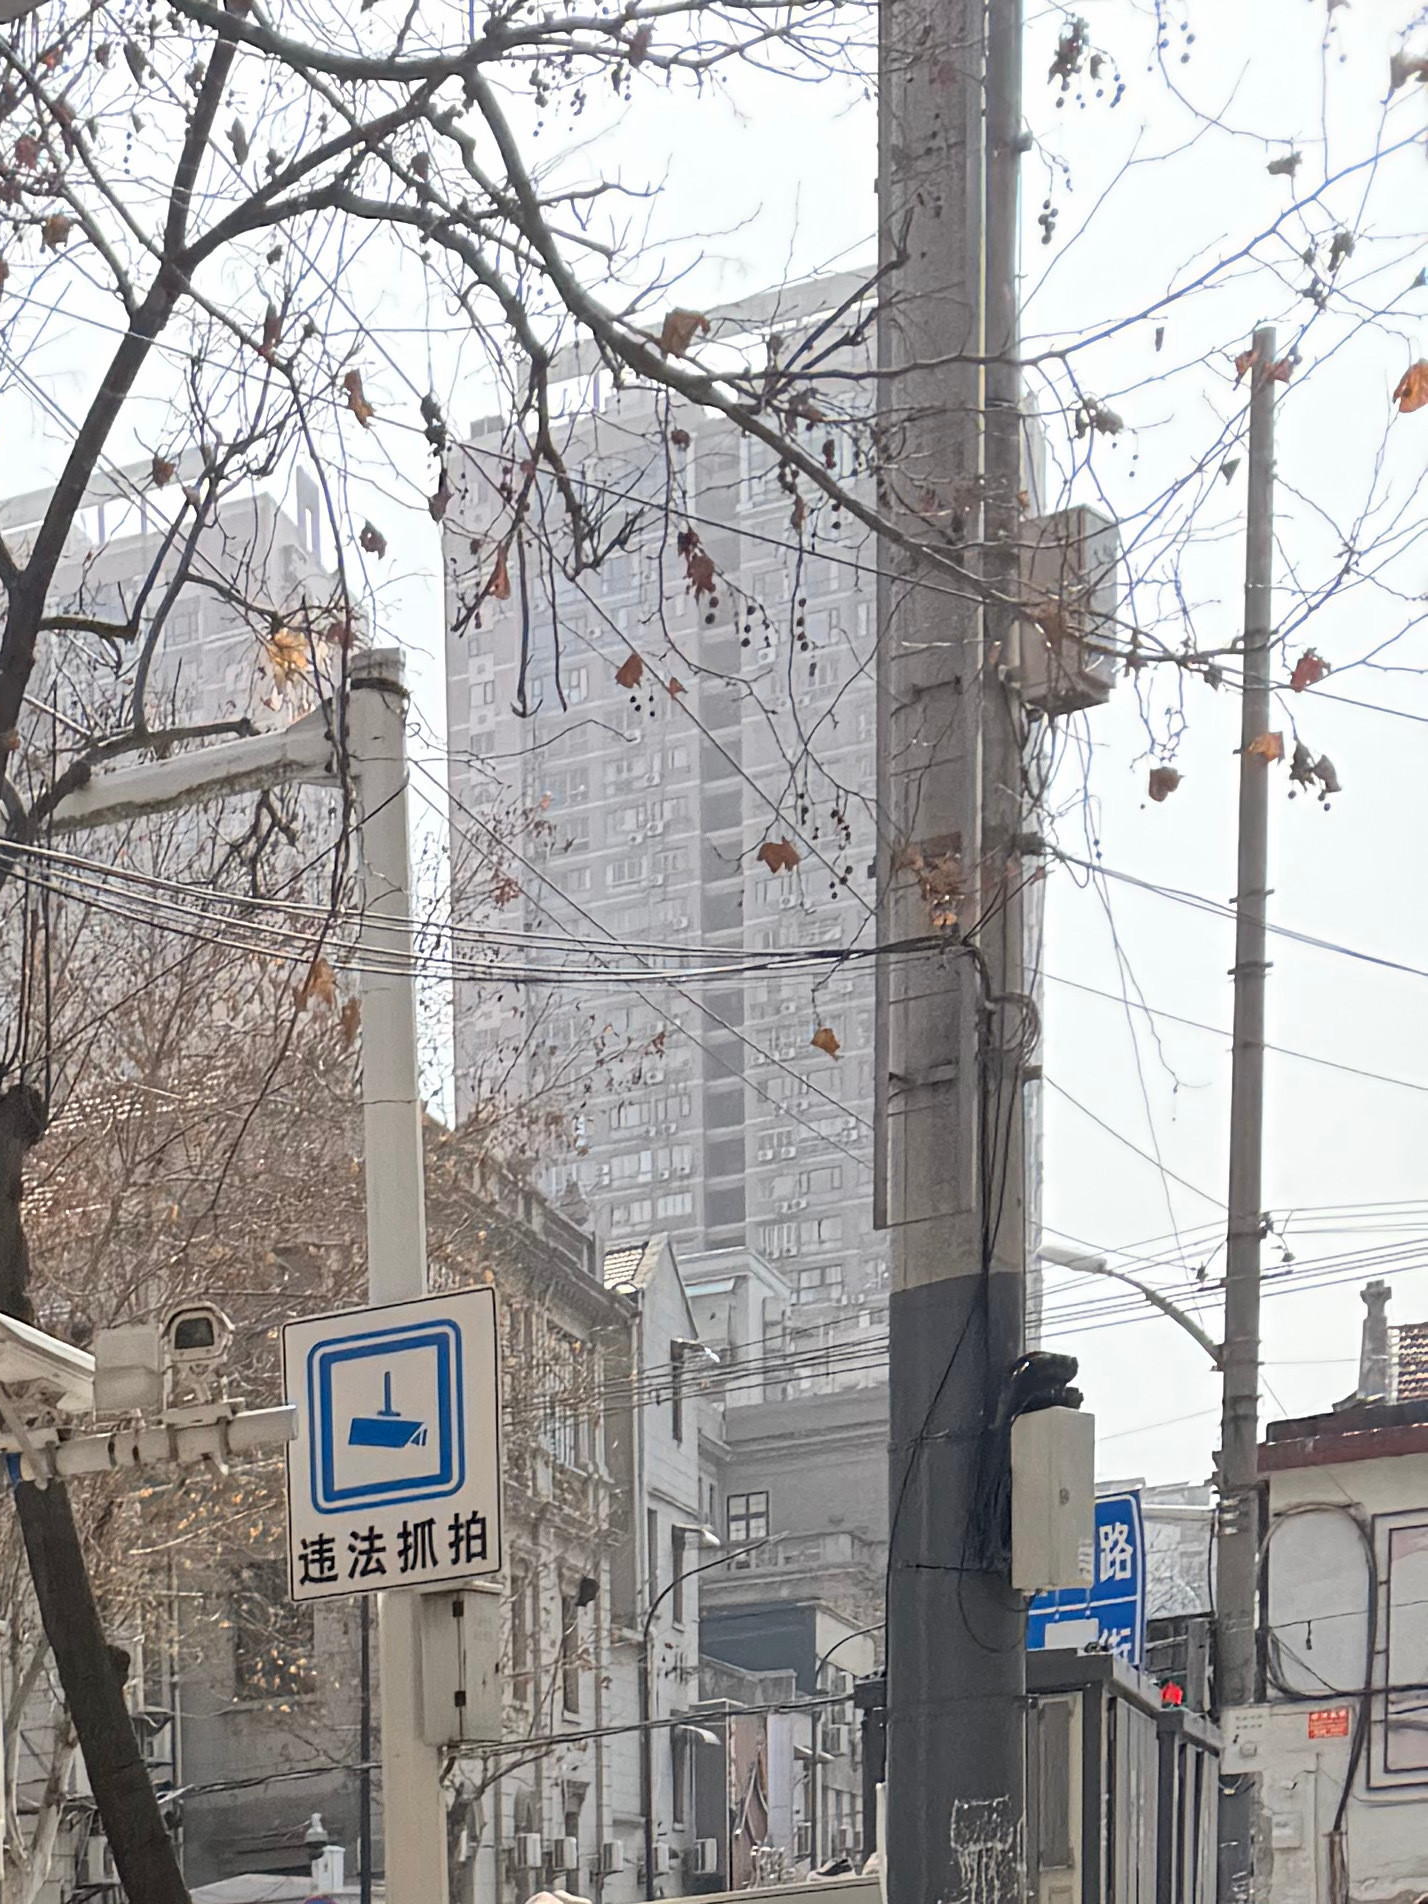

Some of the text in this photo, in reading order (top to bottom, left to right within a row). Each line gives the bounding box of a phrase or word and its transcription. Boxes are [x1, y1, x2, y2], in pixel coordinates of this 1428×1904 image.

[298, 1510, 488, 1586] 违法抓拍
[1098, 1521, 1135, 1584] 路
